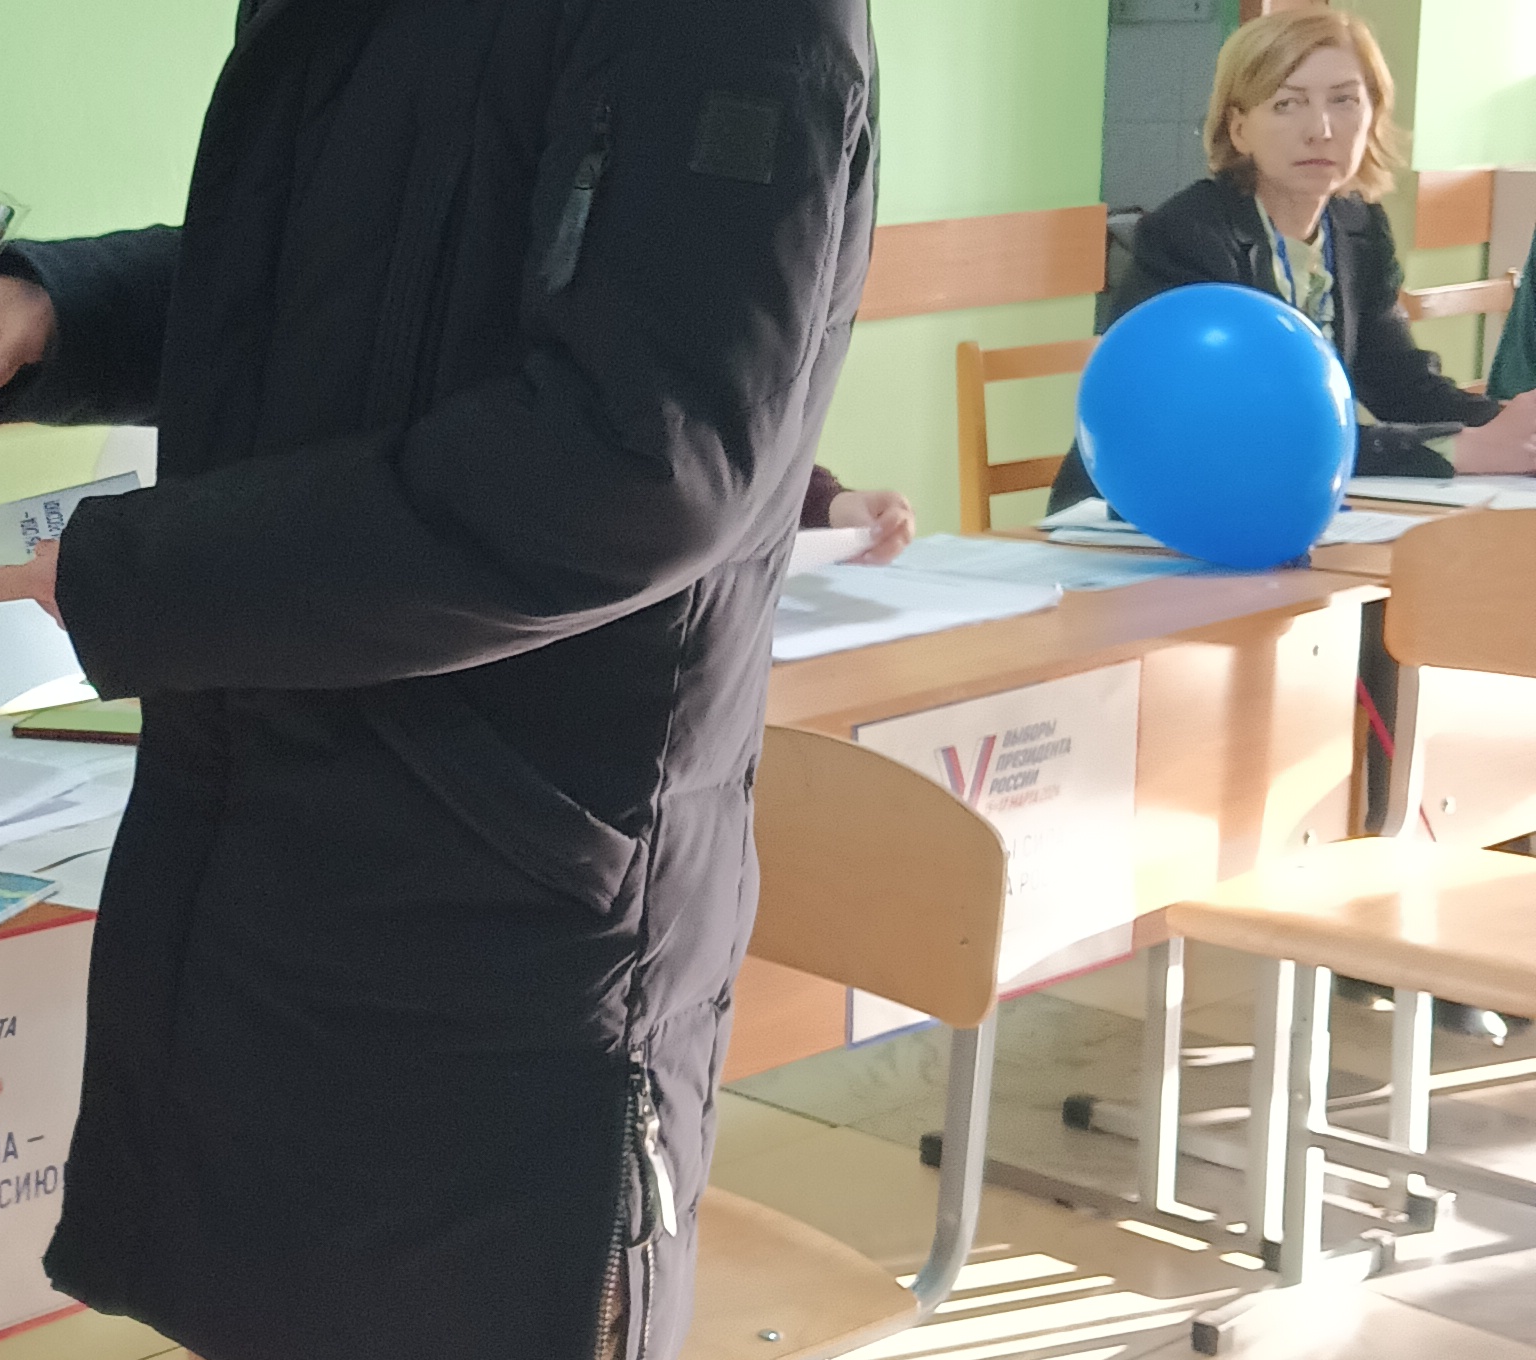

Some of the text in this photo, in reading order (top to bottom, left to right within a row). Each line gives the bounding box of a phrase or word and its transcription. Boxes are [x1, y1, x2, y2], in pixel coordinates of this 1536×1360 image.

[1002, 718, 1057, 748] ВЫБОРЫ
[995, 736, 1071, 772] ПРЕЗИДЕНТА
[989, 769, 1039, 795] РОССИИ
